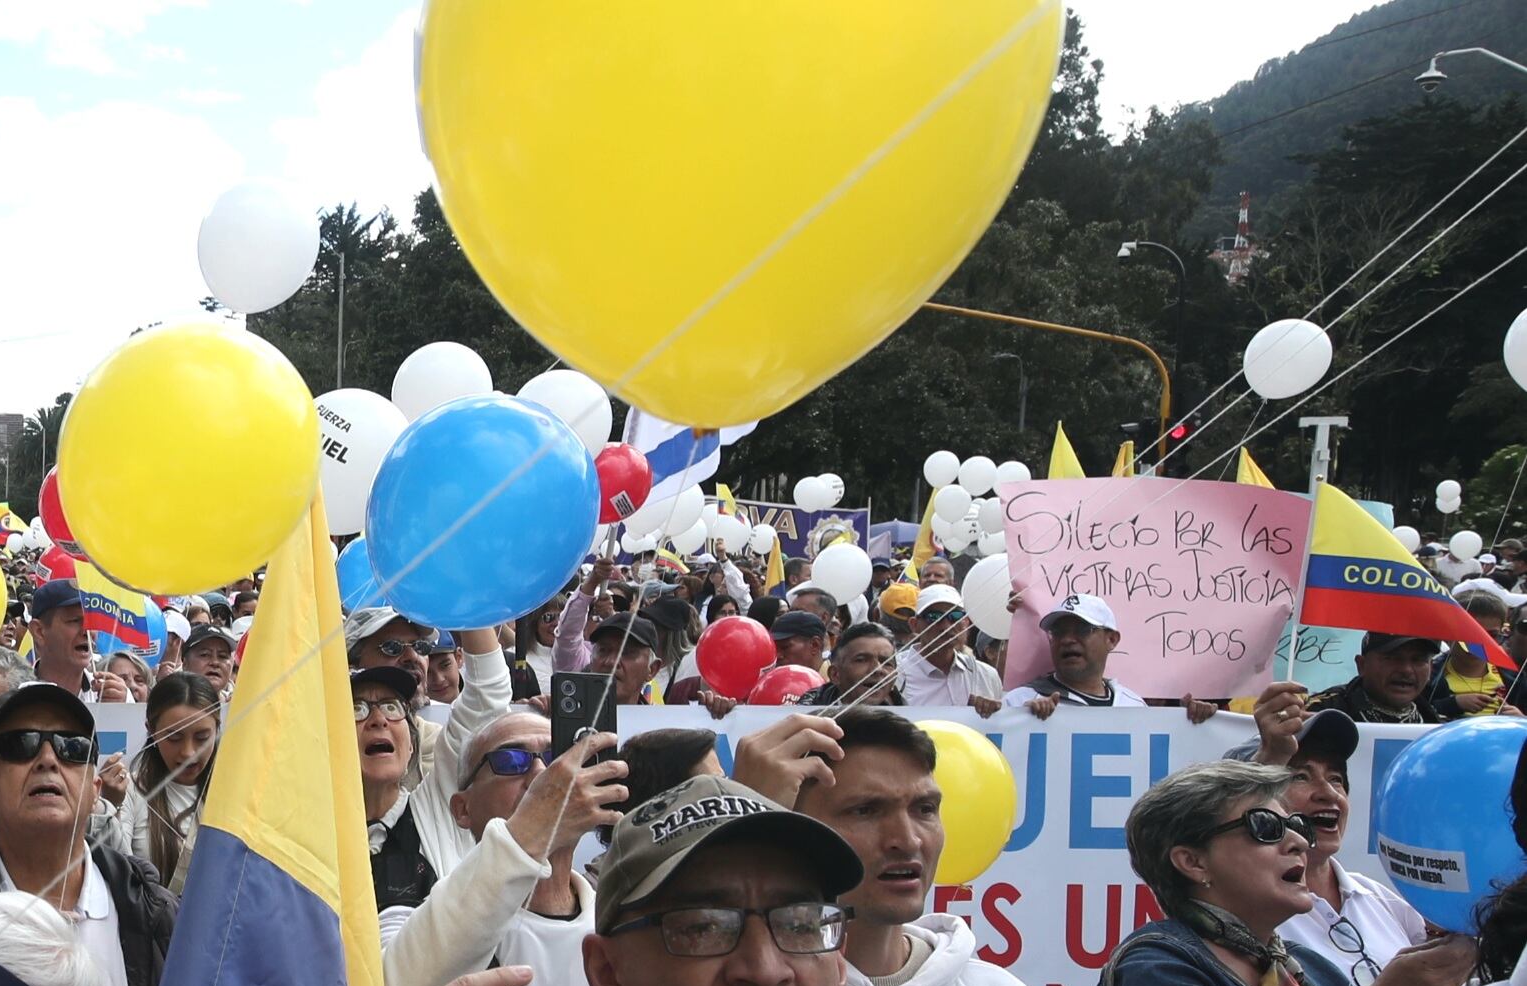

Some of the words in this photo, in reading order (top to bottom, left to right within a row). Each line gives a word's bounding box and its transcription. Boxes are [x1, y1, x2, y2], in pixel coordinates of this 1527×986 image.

[317, 404, 352, 433] FUERZA
[1413, 855, 1424, 867] por
[1426, 857, 1460, 872] respeto,
